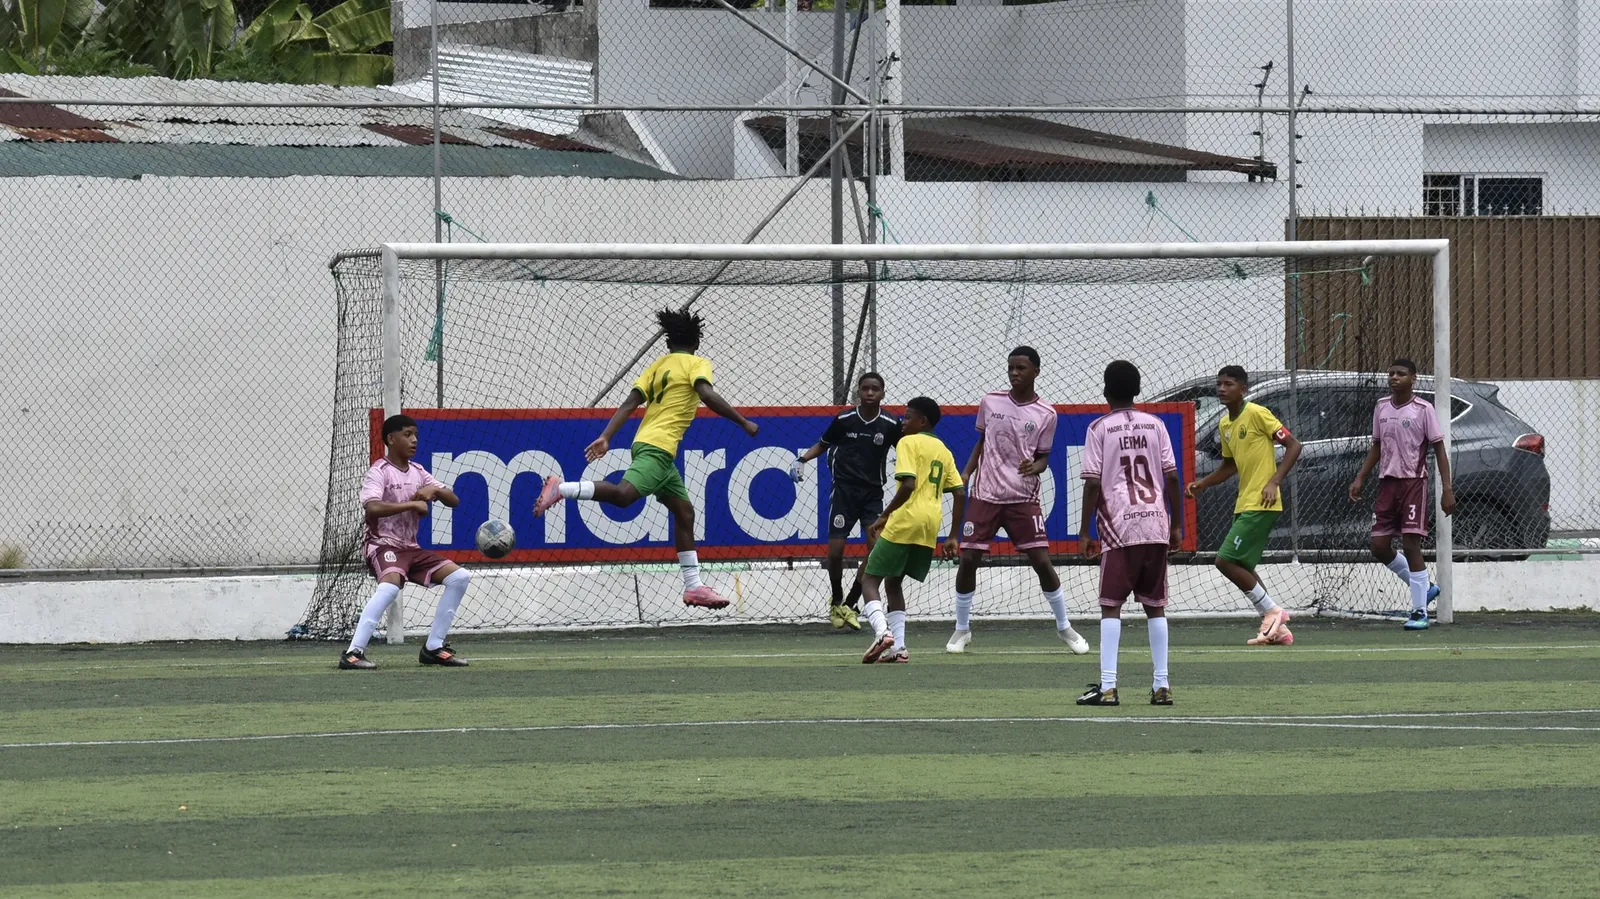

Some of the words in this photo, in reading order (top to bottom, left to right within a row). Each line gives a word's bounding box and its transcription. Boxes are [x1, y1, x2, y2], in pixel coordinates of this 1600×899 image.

[649, 369, 671, 404] 11
[1107, 425, 1123, 434] MADRE
[1132, 423, 1155, 431] SALVADOR
[1277, 430, 1285, 439] C
[929, 460, 943, 499] 9
[1120, 455, 1157, 505] 19
[1409, 505, 1415, 520] 3
[1032, 515, 1045, 532] 14
[1234, 536, 1242, 550] 4
